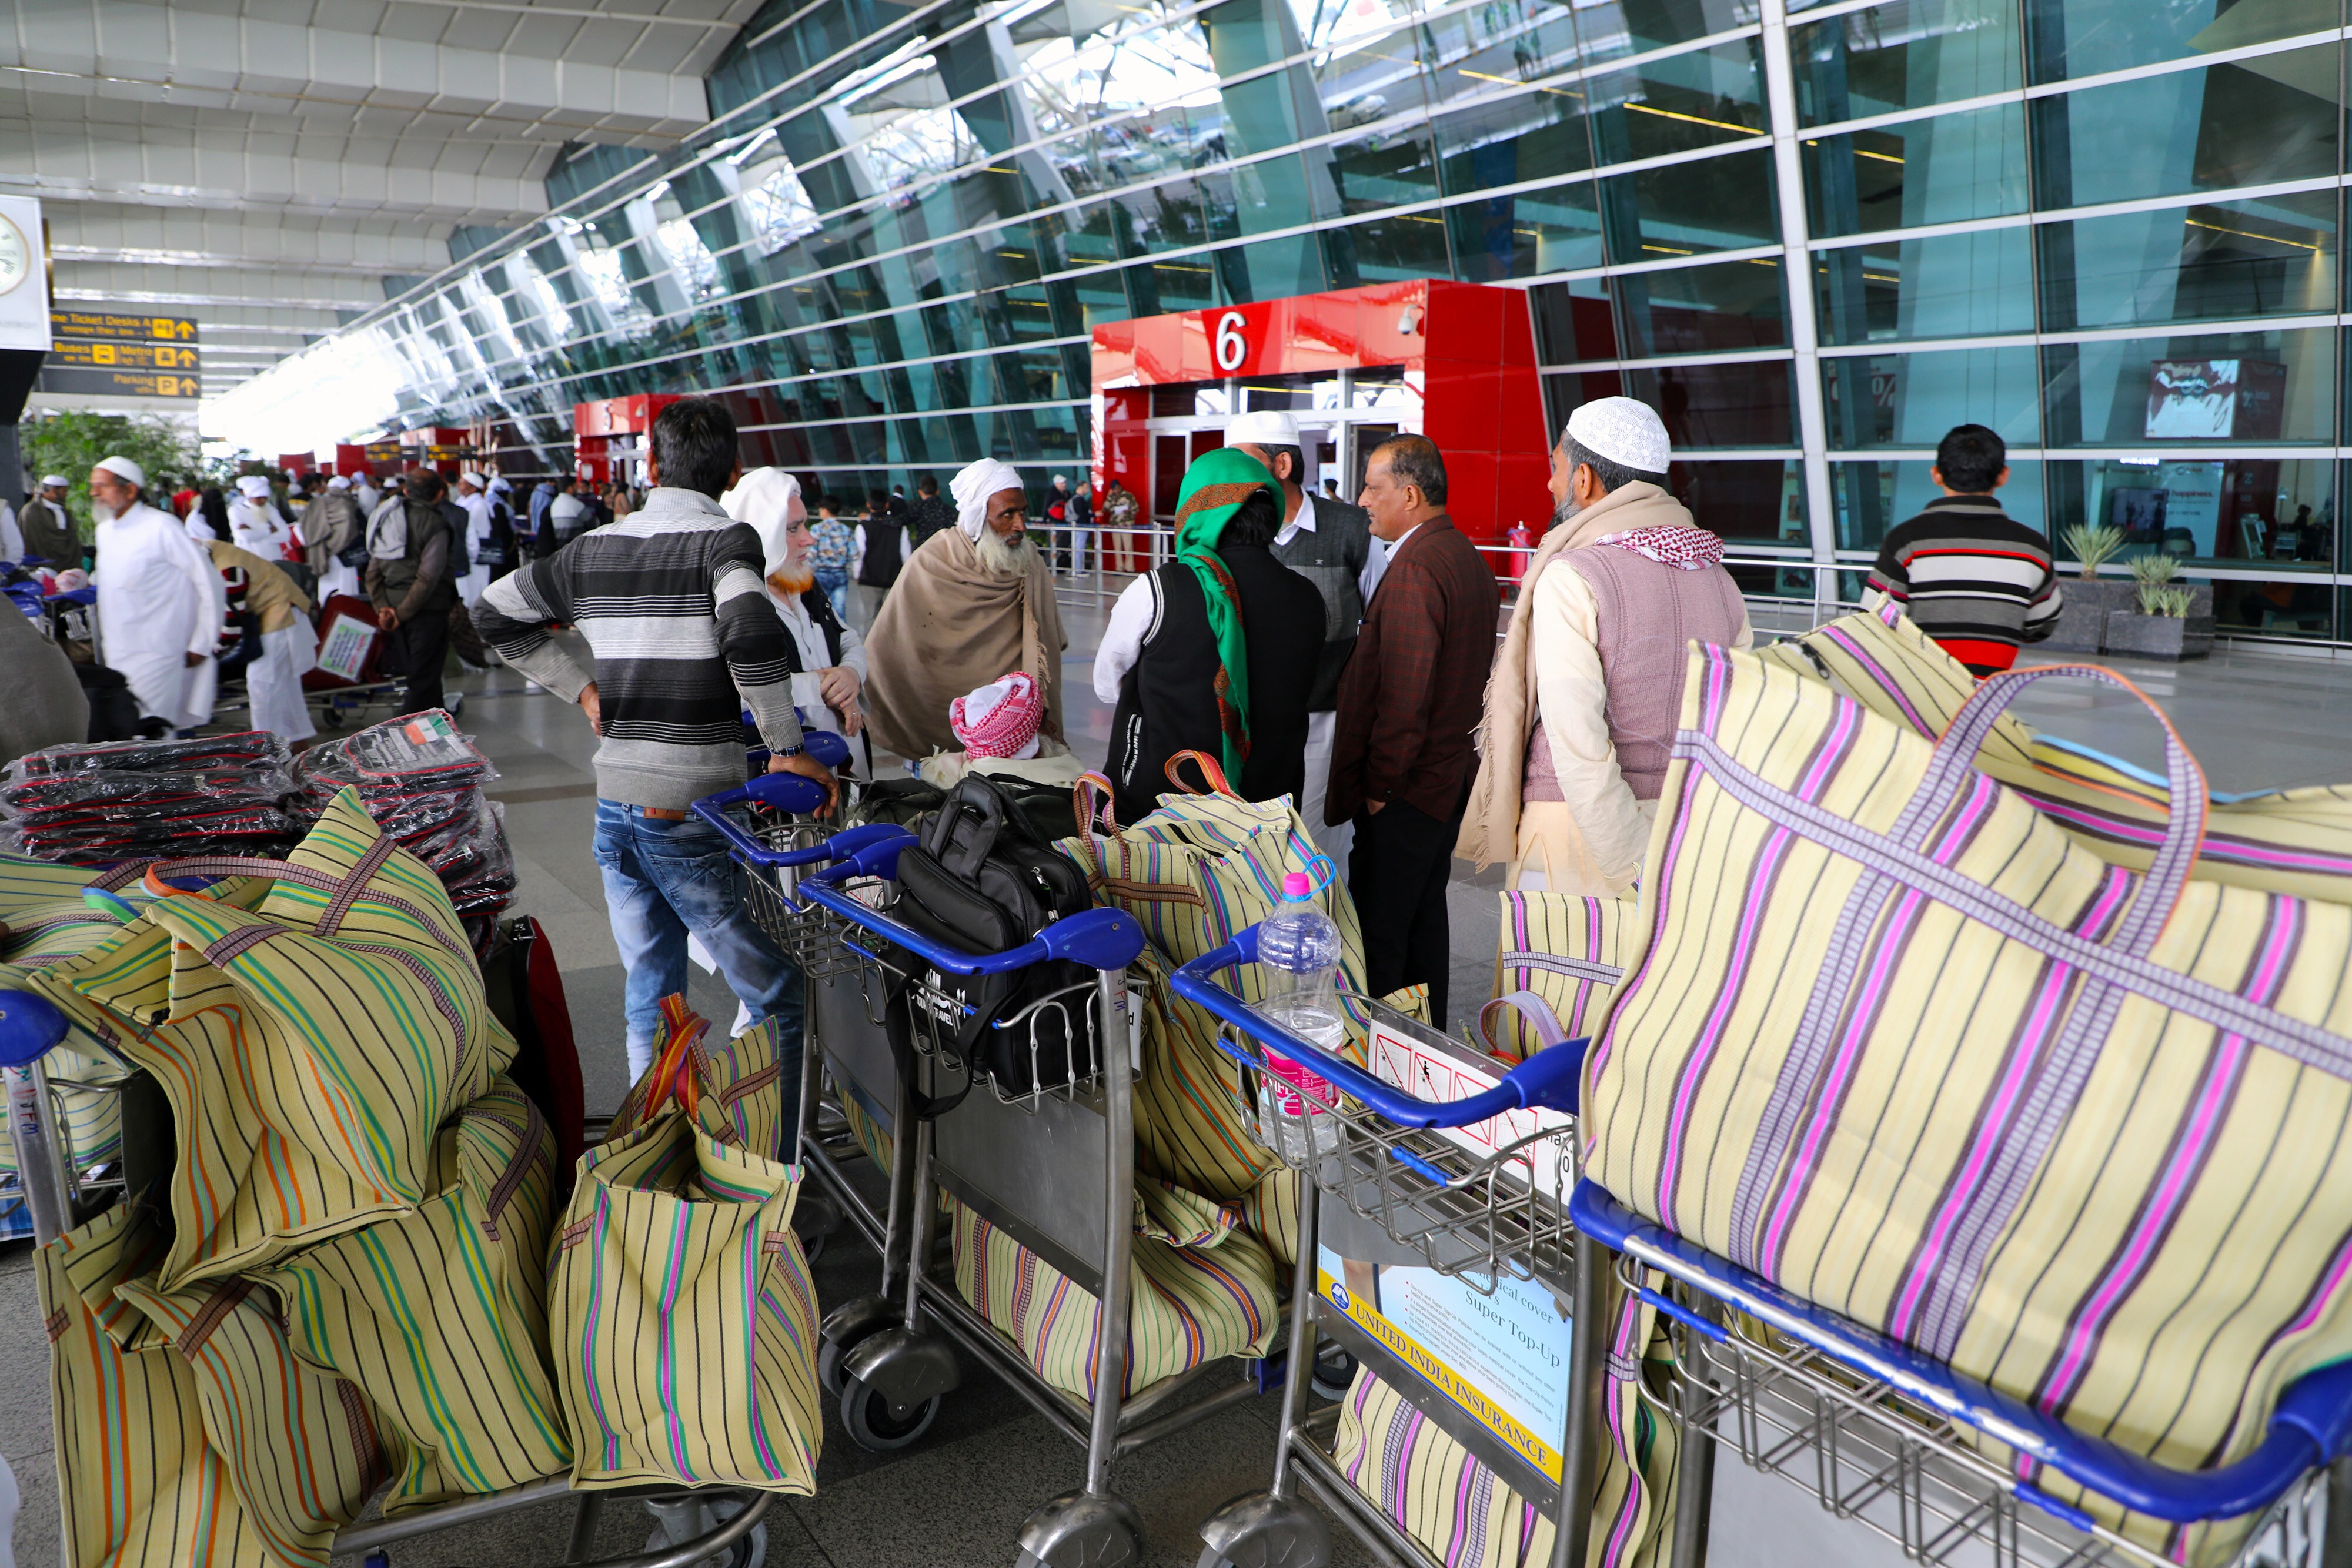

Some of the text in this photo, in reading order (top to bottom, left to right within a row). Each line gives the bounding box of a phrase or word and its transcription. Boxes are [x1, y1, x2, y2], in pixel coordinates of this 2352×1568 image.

[69, 313, 103, 325] Ticket
[54, 342, 91, 353] Buses
[121, 346, 153, 356] Metro
[1215, 311, 1247, 371] 6
[113, 373, 155, 387] Parking
[1521, 1298, 1554, 1325] cover
[1466, 1290, 1559, 1368] Super Top-Up
[1356, 1303, 1406, 1352] UNITED
[1410, 1345, 1451, 1389] INDIA
[1455, 1380, 1547, 1465] INSURANCE
